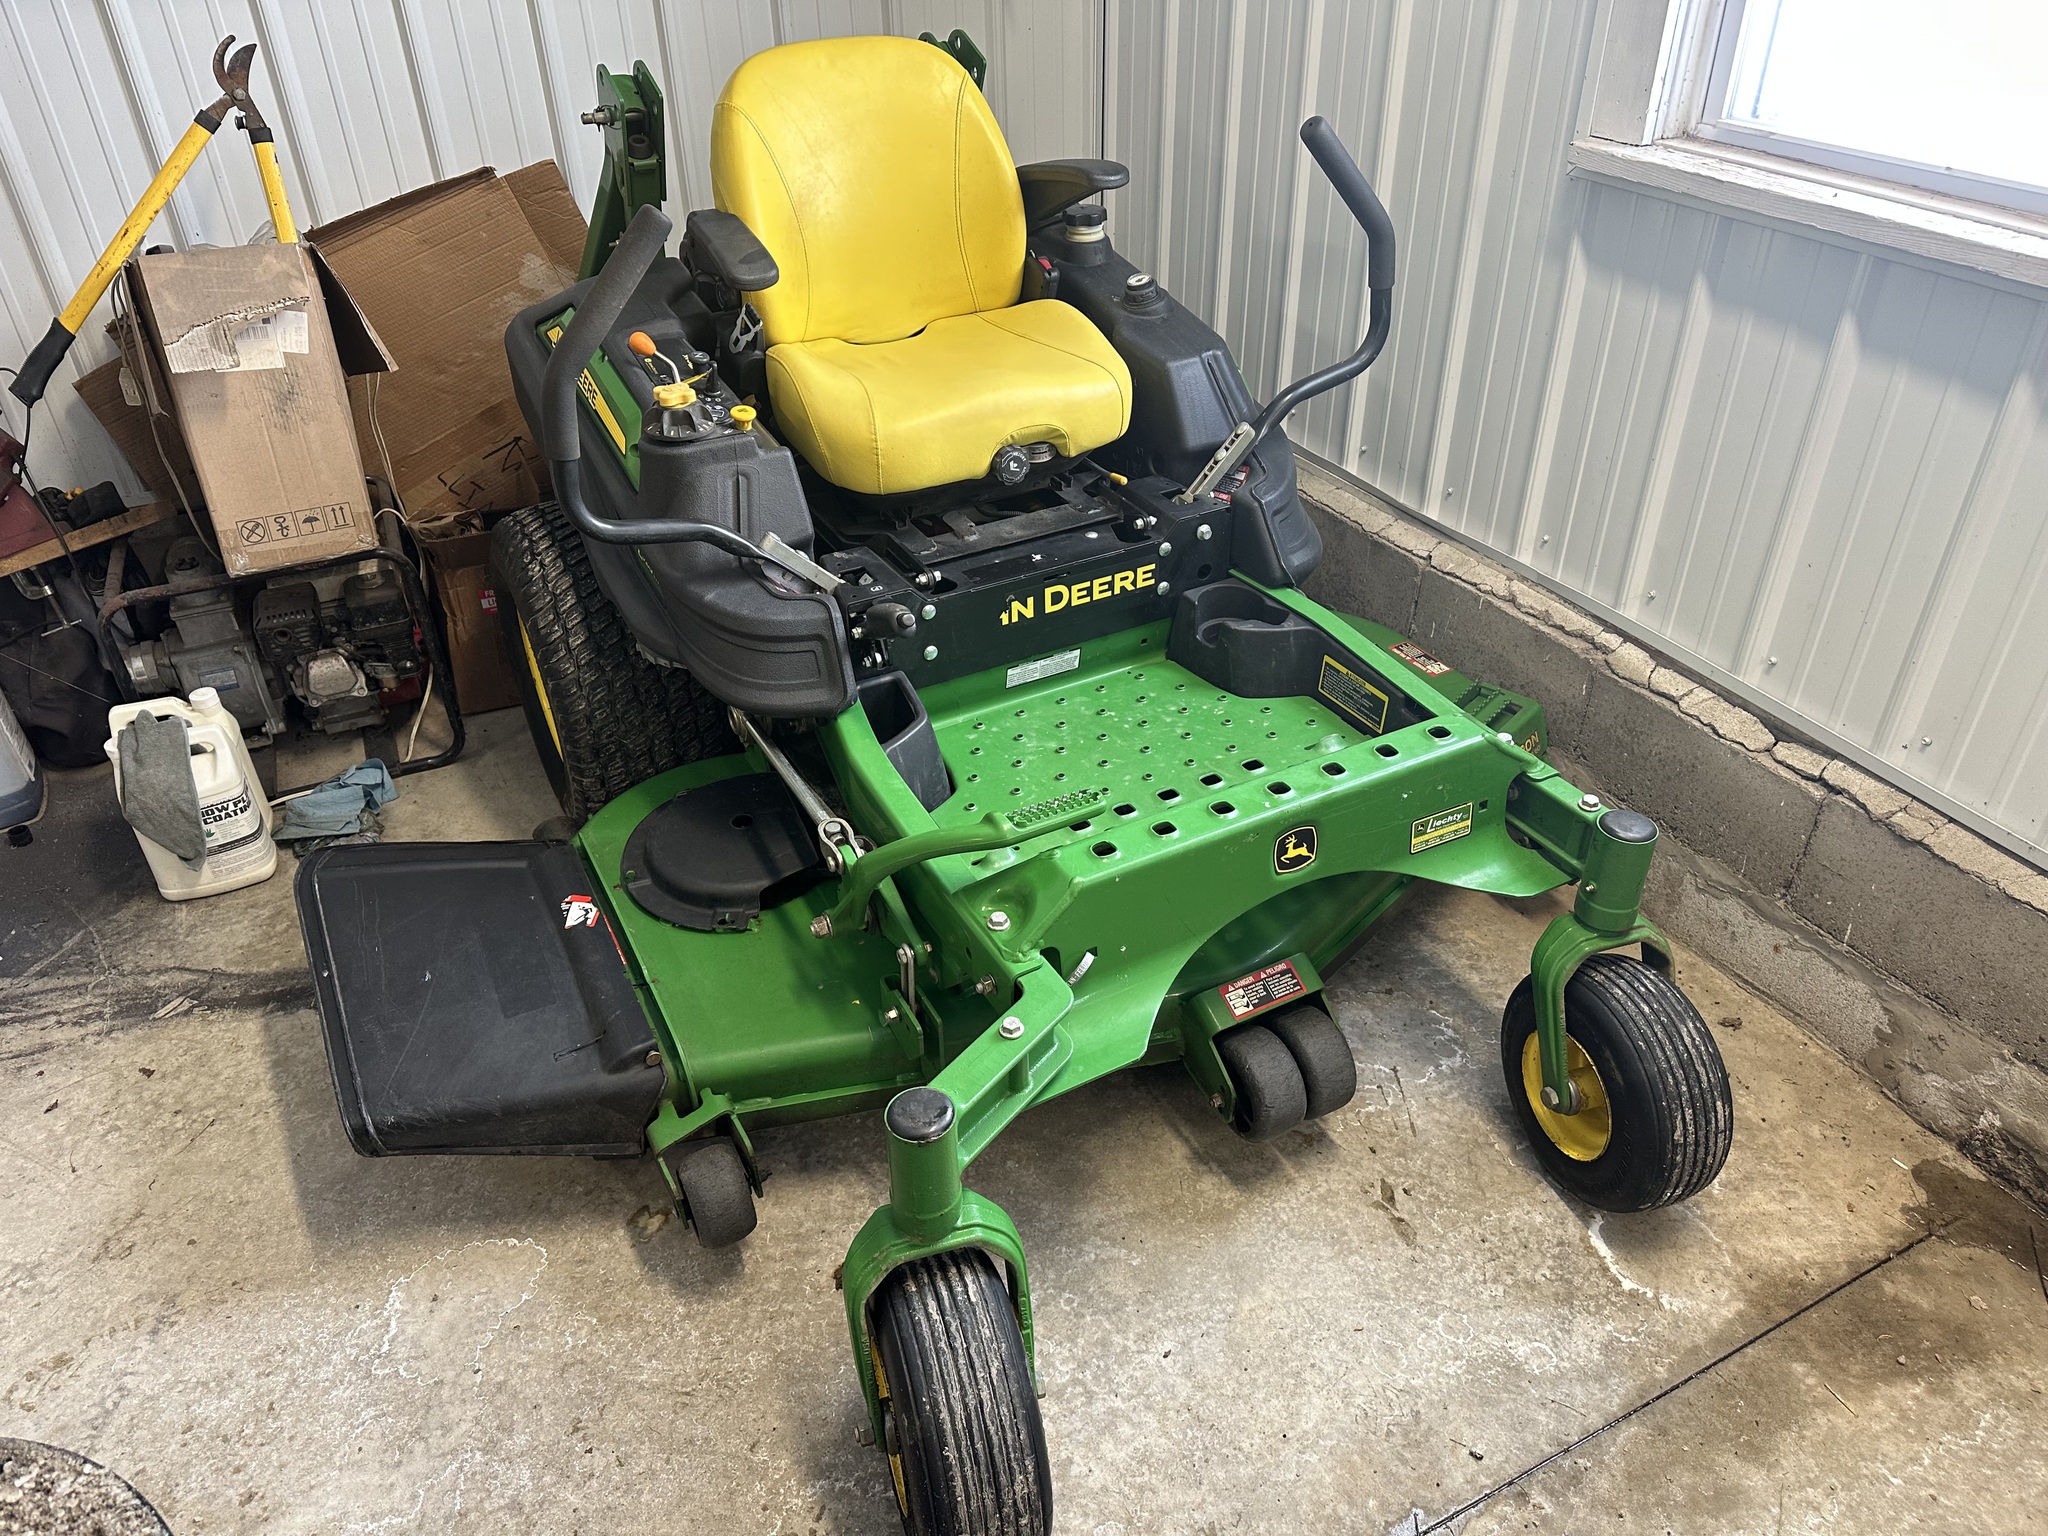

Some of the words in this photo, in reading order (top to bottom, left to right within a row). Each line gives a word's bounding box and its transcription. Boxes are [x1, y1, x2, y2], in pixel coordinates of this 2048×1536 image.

[1044, 563, 1156, 614] DEERE
[1233, 975, 1255, 988] DANGER
[1265, 962, 1287, 976] PELIGRO
